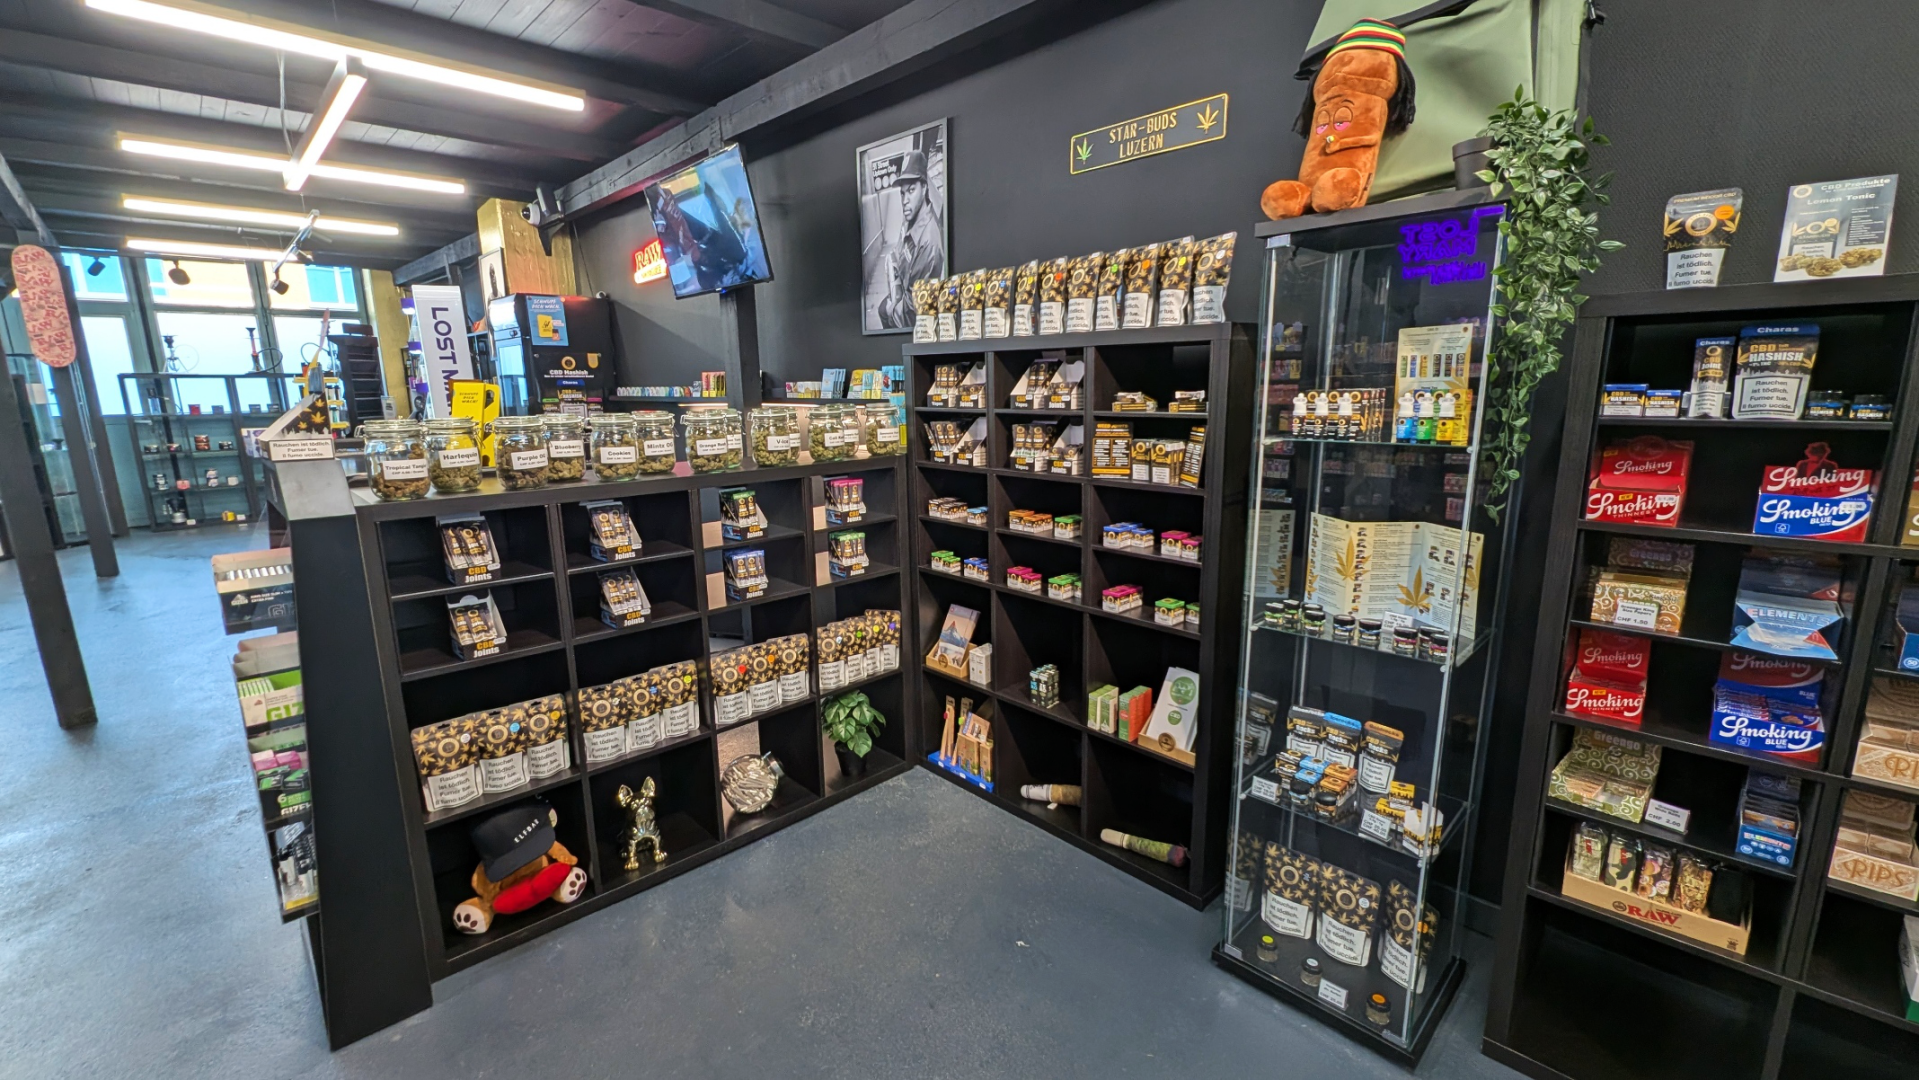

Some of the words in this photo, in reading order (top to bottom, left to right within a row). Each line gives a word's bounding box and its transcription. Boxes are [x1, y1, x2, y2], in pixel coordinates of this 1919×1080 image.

[1109, 112, 1177, 144] STAR-BUDS
[1119, 133, 1164, 158] LUZERN
[873, 168, 888, 177] Uptown
[888, 164, 897, 173] Only
[1845, 178, 1891, 188] Produkte
[1807, 197, 1843, 205] Lemon
[1845, 192, 1876, 201] Tonic
[635, 240, 661, 271] RAW
[1680, 252, 1713, 260] Rauchen
[1675, 270, 1698, 278] Fumer
[431, 307, 457, 365] LOST
[1749, 343, 1777, 353] CBD
[1748, 352, 1804, 363] HASHISH
[516, 454, 539, 462] Purple
[1613, 460, 1673, 475] Smoking
[1766, 467, 1866, 493] Smoking
[1586, 492, 1680, 520] Smoking
[1613, 508, 1657, 519] THINNEST
[1759, 499, 1856, 527] Smoking
[1809, 516, 1833, 525] BLUE
[746, 530, 763, 539] Joints
[617, 545, 633, 553] CBD
[614, 551, 636, 560] Joints
[468, 566, 487, 575] CBD
[464, 573, 492, 584] Joints
[746, 590, 764, 599] Joints
[626, 611, 642, 620] CBD
[1747, 607, 1831, 627] ELEMENTS
[623, 617, 645, 627] Joints
[477, 640, 494, 650] CBD
[473, 646, 500, 658] Joints
[1583, 647, 1643, 668] Smoking
[1566, 688, 1645, 717] Smoking
[1170, 712, 1181, 720] CBD
[1295, 724, 1316, 734] Rocks
[1719, 715, 1813, 750] Smoking
[1328, 733, 1348, 744] Rocks
[1594, 729, 1641, 751] Greengo
[1765, 738, 1788, 746] BLUE
[1368, 742, 1389, 754] Rocks
[439, 770, 468, 783] Rauchen
[488, 774, 507, 782] Fumer
[277, 793, 287, 804] 6
[439, 788, 461, 798] Fumer
[1648, 813, 1663, 821] CHF
[1665, 818, 1681, 828] 2.00
[513, 818, 540, 844] ELFBAR
[1843, 858, 1911, 888] RIPS
[1271, 898, 1298, 911] Rauchen
[1276, 907, 1299, 918] tödlich.
[1627, 904, 1682, 926] RAW
[1286, 918, 1298, 926] tue.
[1280, 925, 1302, 934] uccide.
[1328, 920, 1355, 938] Rauchen
[1332, 931, 1356, 945] tödlich.
[1343, 944, 1355, 952] tue.
[1395, 964, 1408, 976] tue.
